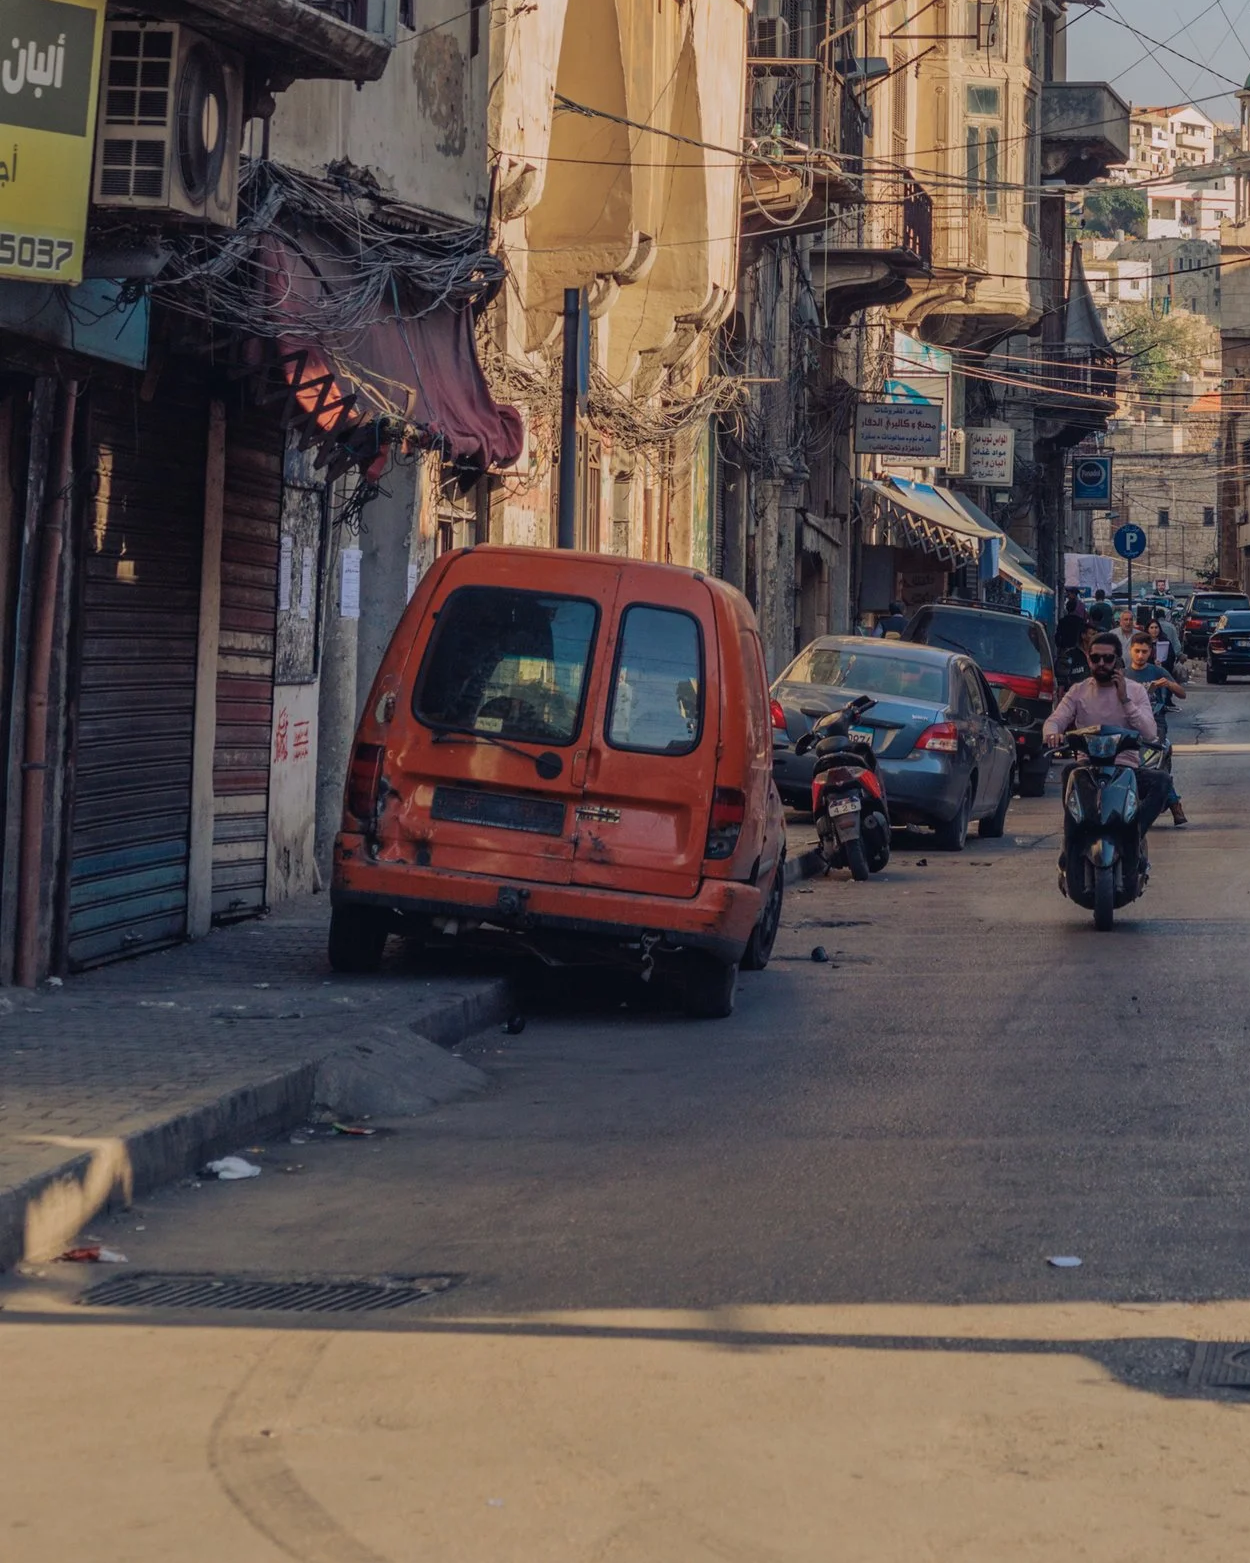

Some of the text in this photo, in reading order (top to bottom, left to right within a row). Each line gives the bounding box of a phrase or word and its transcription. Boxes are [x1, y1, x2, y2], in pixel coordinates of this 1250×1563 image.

[2, 33, 66, 99] ألبان
[917, 420, 937, 430] مصنع
[991, 449, 1007, 458] مواد
[989, 457, 1007, 468] ألبان
[1126, 533, 1138, 551] P
[833, 802, 857, 815] 425
